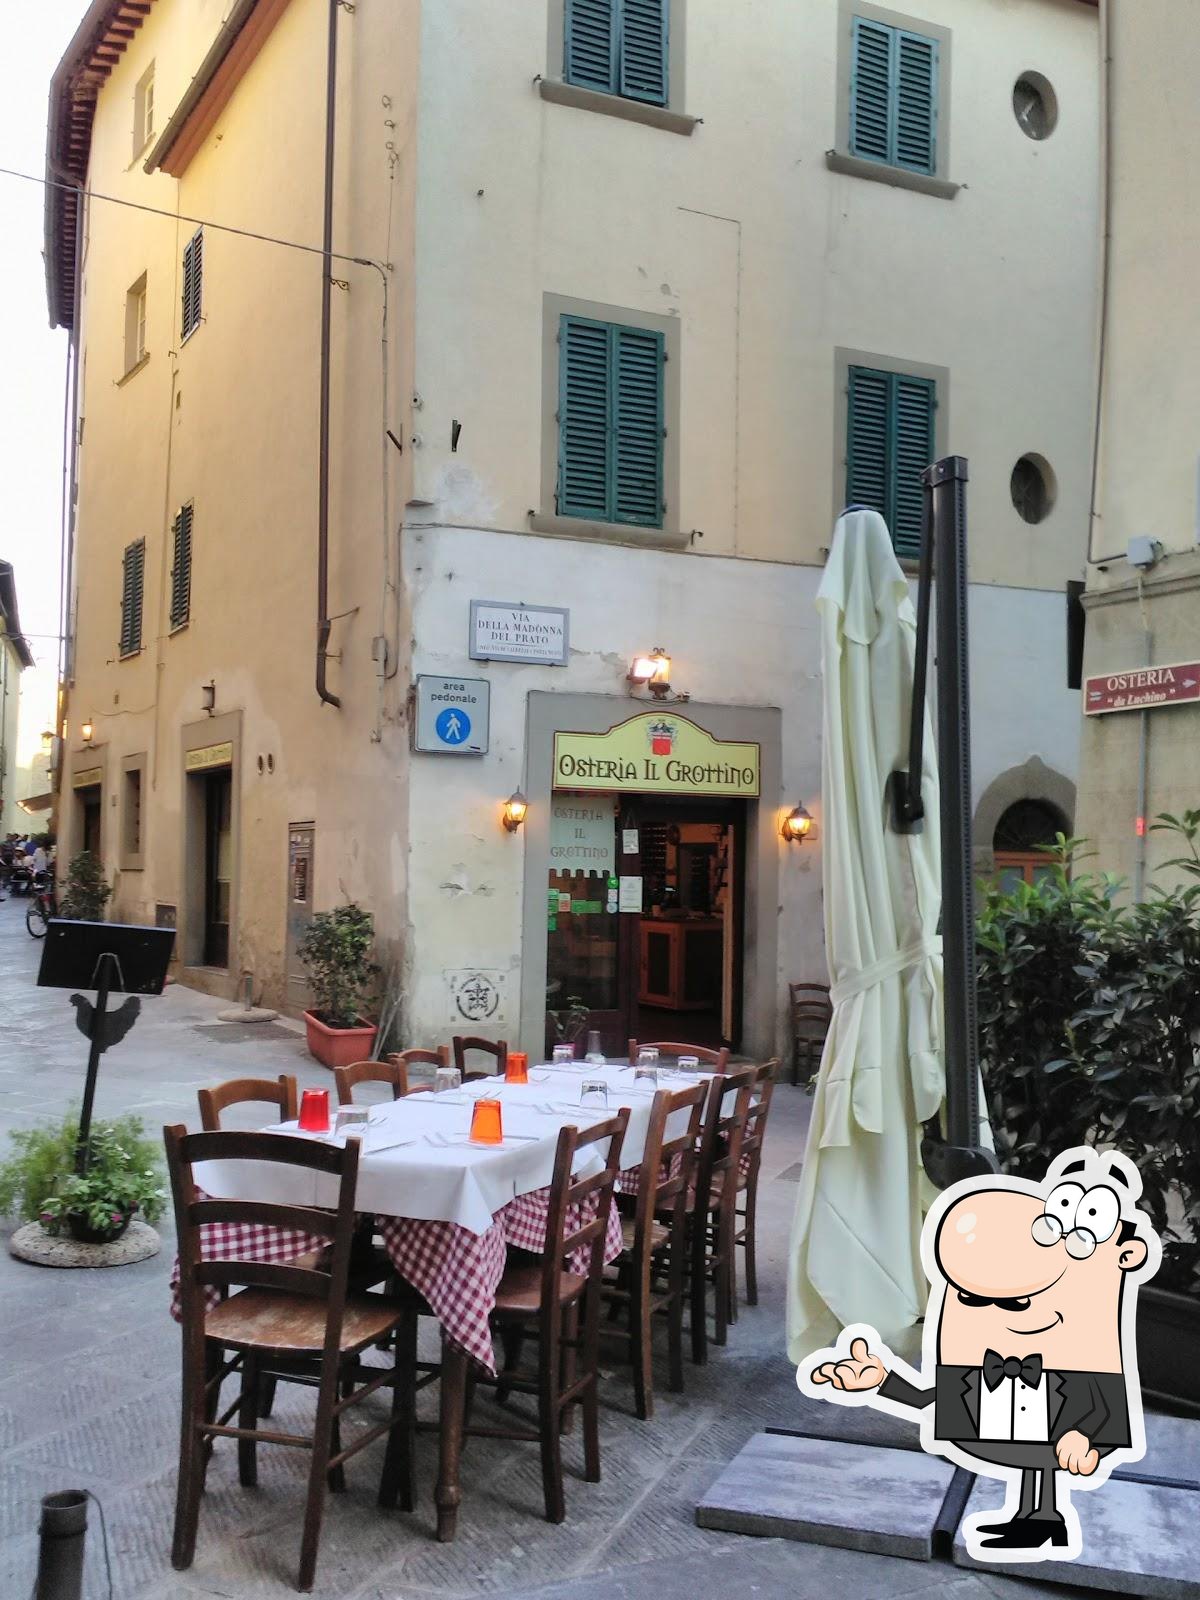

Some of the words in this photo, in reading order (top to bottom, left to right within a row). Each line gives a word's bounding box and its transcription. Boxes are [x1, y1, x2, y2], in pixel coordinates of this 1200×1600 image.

[512, 612, 530, 622] VIA
[478, 620, 509, 631] DELLA
[513, 623, 562, 635] MADONNA
[491, 631, 509, 641] DEL
[515, 633, 549, 644] PRATO
[1106, 668, 1175, 692] OSTERIA
[443, 683, 465, 691] area
[431, 693, 477, 703] pedonale
[554, 808, 604, 821] OSTERIA
[574, 828, 586, 839] IL
[550, 846, 609, 860] GROTTINO
